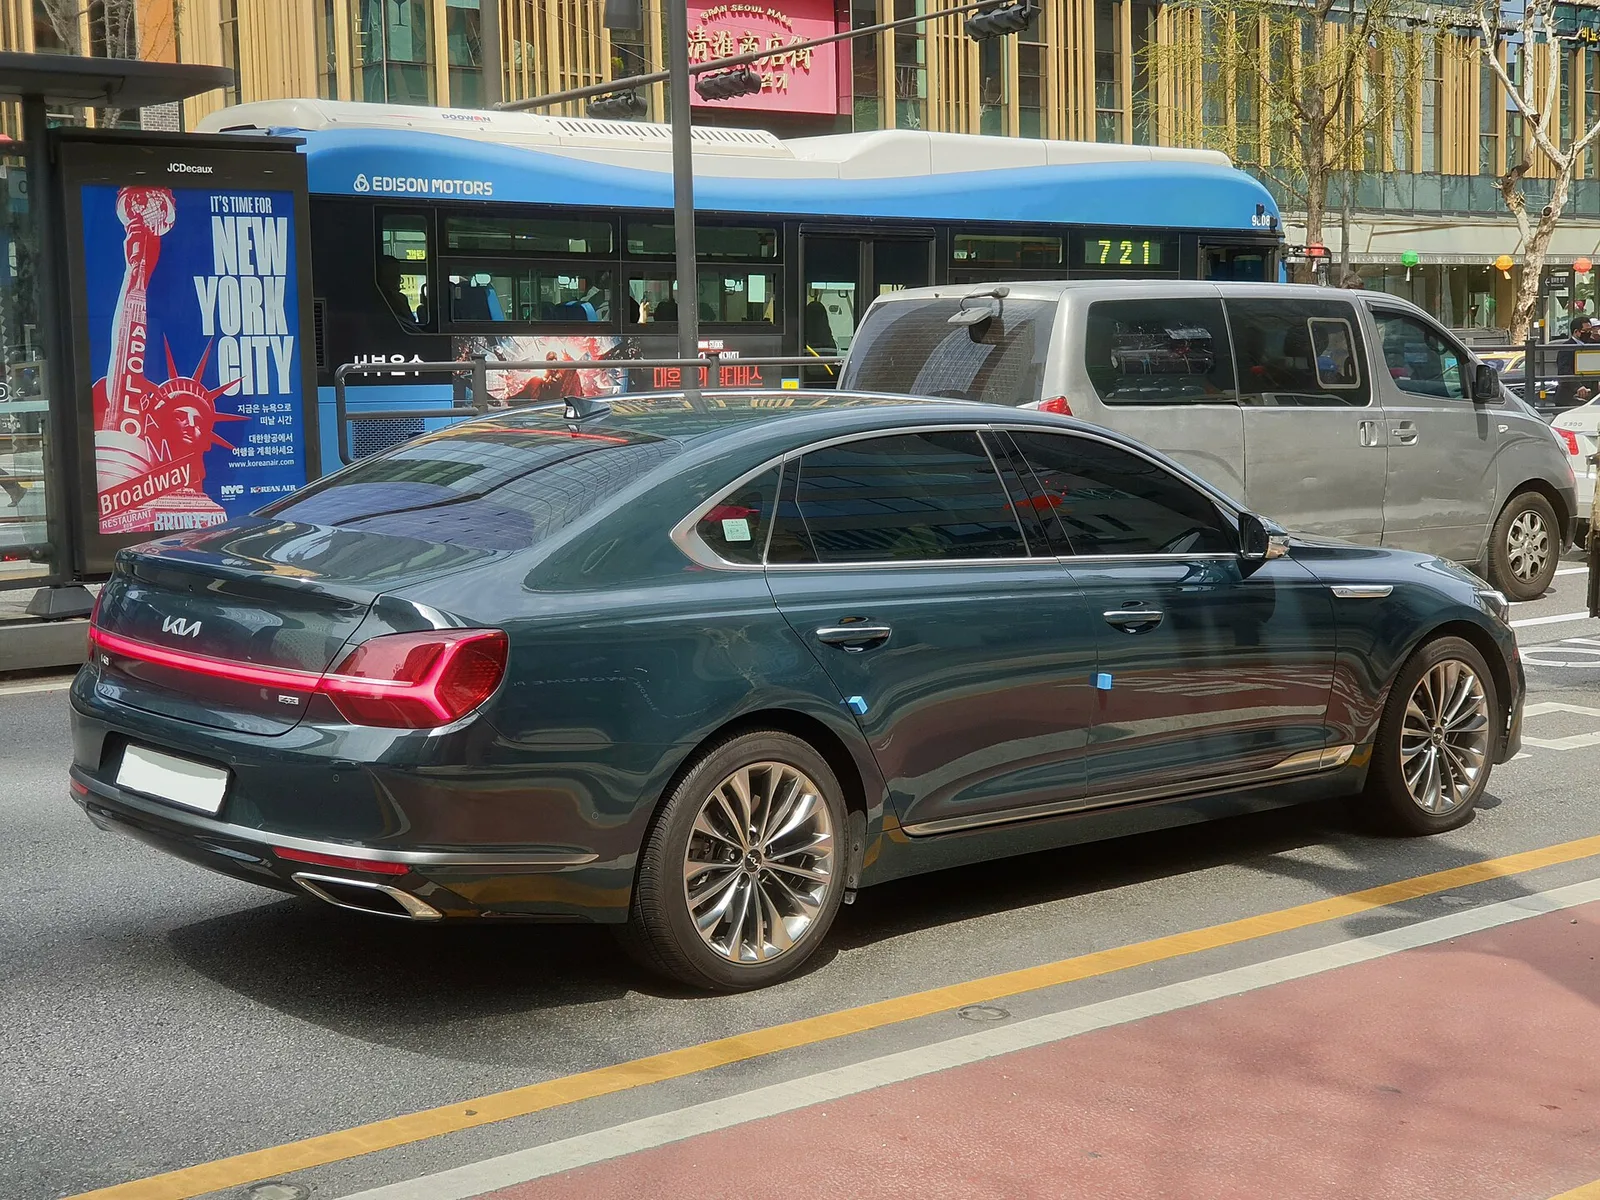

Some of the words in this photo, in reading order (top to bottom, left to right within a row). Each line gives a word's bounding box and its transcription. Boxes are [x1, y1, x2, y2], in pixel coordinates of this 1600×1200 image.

[701, 4, 728, 19] GRAN
[730, 4, 765, 13] SEOUL
[767, 8, 792, 26] MALL
[167, 163, 213, 174] JCDecaux
[372, 176, 428, 193] EDISON
[431, 179, 493, 196] MOTORS
[210, 195, 229, 213] IT'S
[230, 196, 254, 214] TIME
[254, 197, 272, 214] FOR
[211, 216, 288, 275] NEW
[193, 276, 289, 336] YORK
[218, 336, 294, 396] CITY
[120, 325, 147, 438] APOLLO
[237, 404, 260, 414] 지금은
[262, 403, 292, 413] 뉴욕으로
[260, 415, 276, 425] 떠날
[277, 415, 293, 425] 시간
[248, 433, 293, 444] 대한항공에서
[231, 447, 255, 457] 여행을
[256, 446, 294, 456] 계획하세요
[228, 459, 295, 469] www.koreanair.com
[100, 463, 190, 516] Broadway
[220, 484, 244, 495] NYC
[250, 485, 281, 494] KOREAN
[281, 484, 297, 492] AIR
[102, 509, 152, 530] RESTAURANT
[154, 512, 202, 532] BRONX
